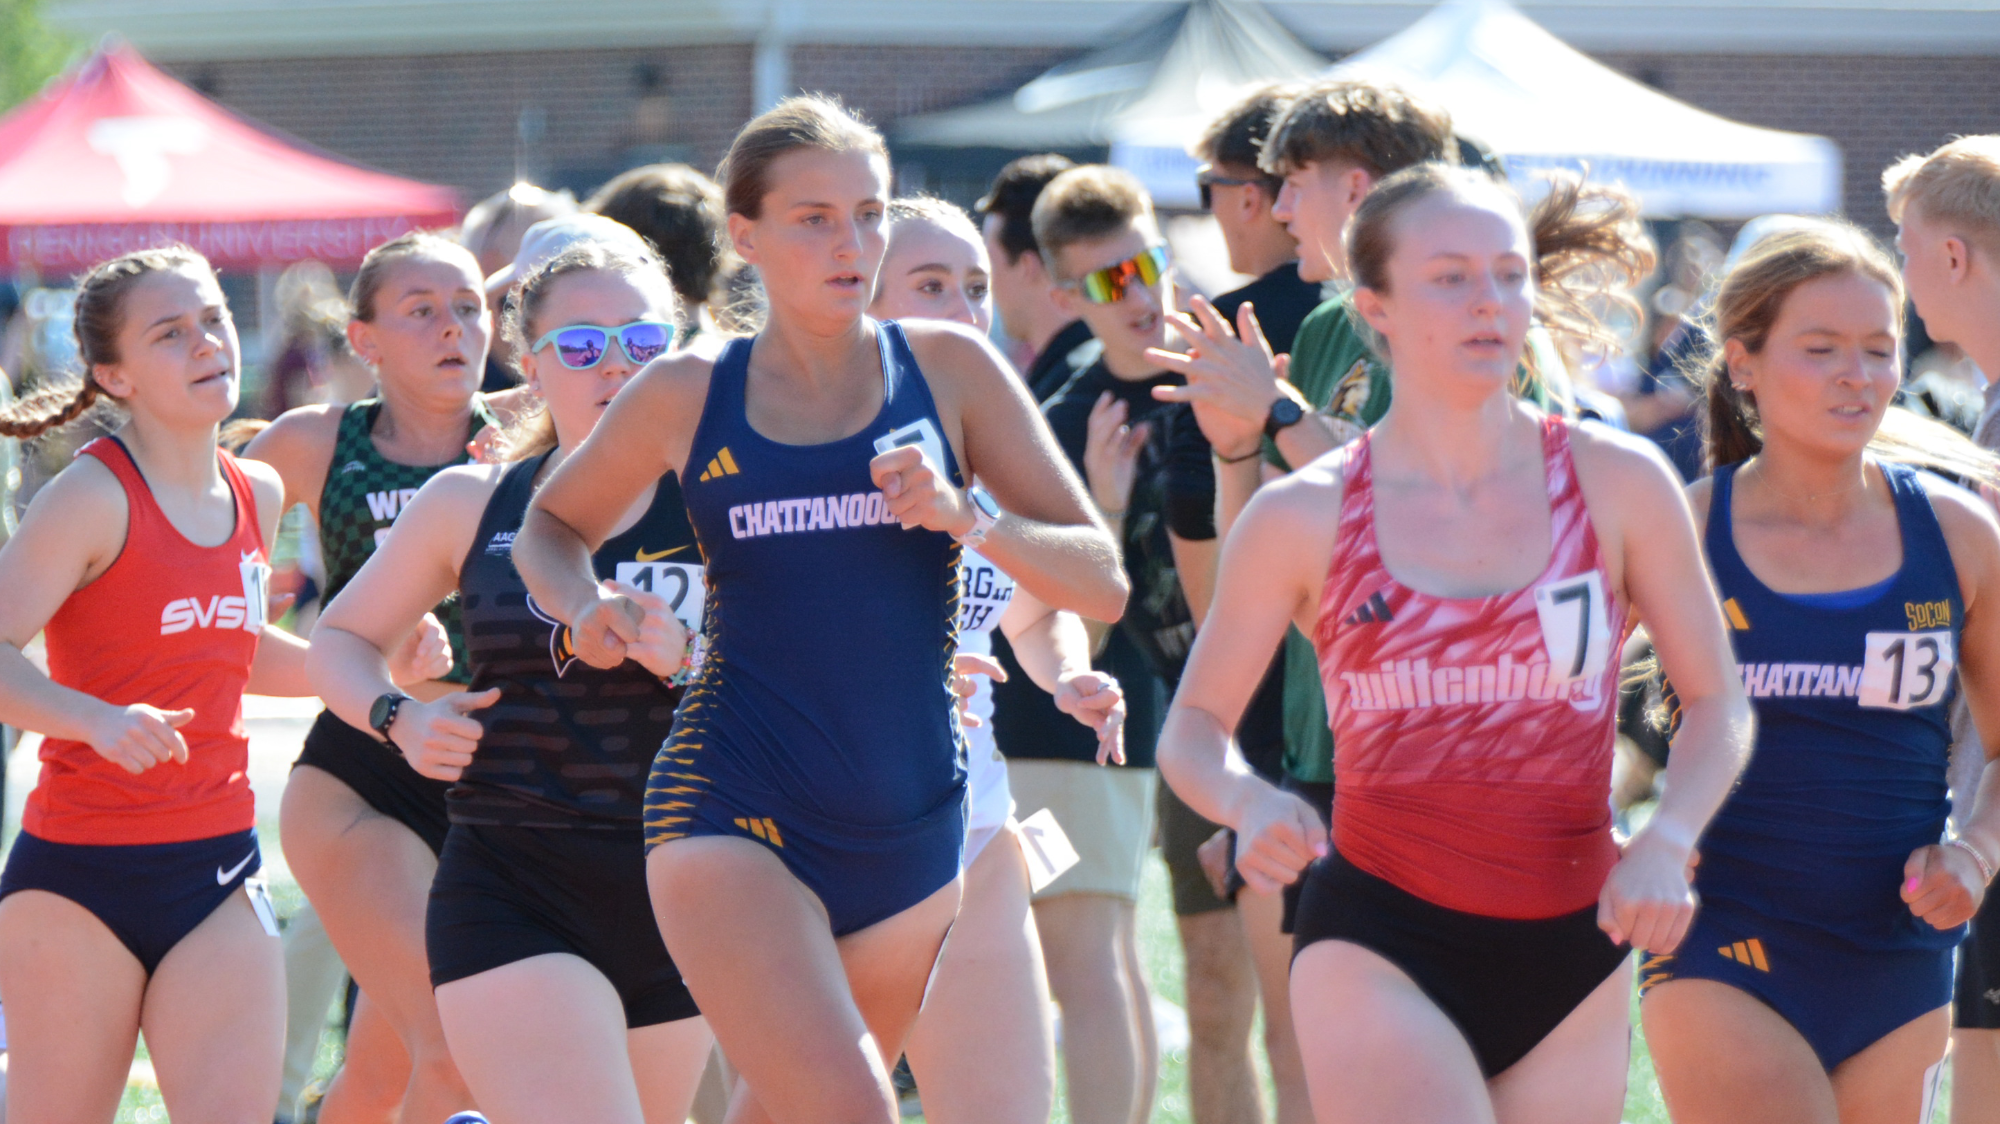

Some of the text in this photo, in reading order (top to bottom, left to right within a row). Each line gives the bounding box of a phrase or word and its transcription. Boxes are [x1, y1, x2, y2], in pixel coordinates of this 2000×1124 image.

[728, 491, 901, 539] CHATTANOO
[160, 594, 261, 636] SVS
[1550, 581, 1591, 678] 7
[1736, 663, 1862, 697] HATTAN
[1882, 637, 1939, 704] 13
